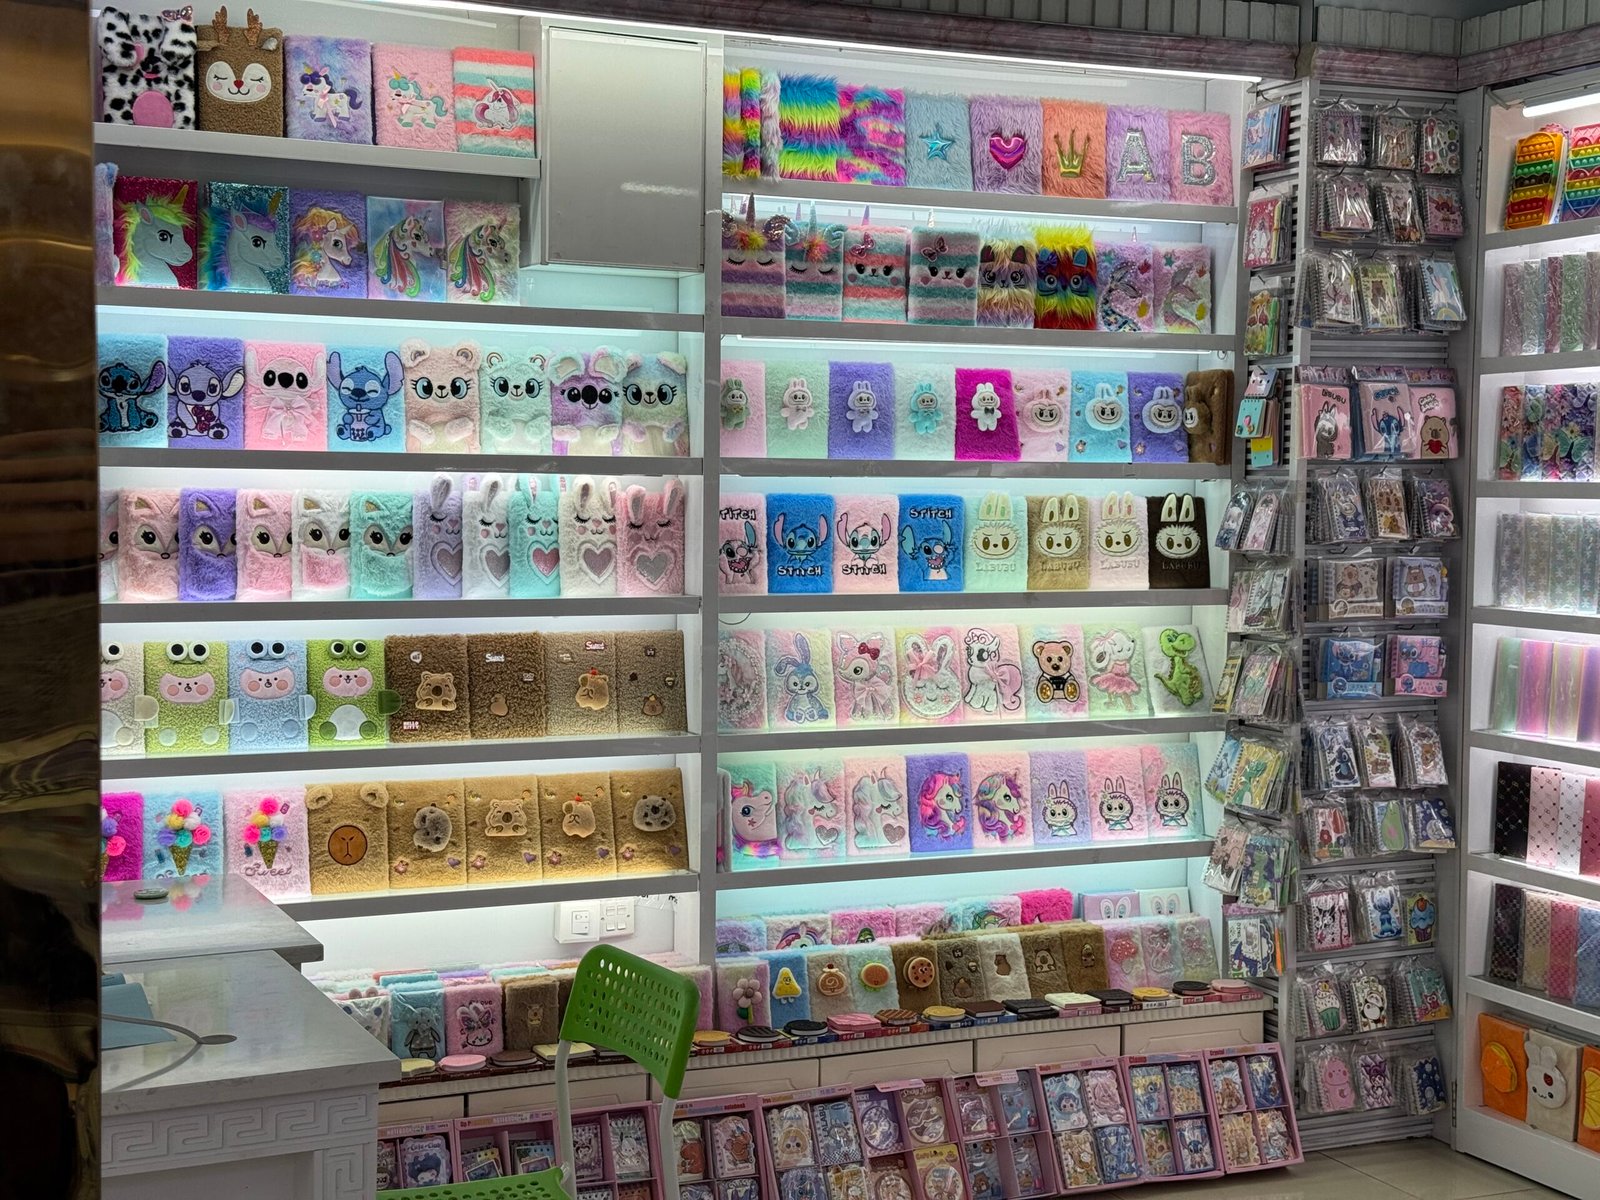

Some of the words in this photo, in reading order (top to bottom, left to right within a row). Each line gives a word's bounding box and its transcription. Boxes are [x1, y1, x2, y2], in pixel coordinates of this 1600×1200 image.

[1117, 127, 1157, 184] A
[1181, 131, 1216, 187] B
[720, 508, 756, 521] TITCH
[908, 507, 953, 520] STITCH
[777, 564, 823, 577] STITCH
[841, 563, 887, 576] STITCH
[975, 561, 1017, 572] LABUBU
[1100, 559, 1141, 571] LABUBU
[244, 863, 293, 877] Sweet
